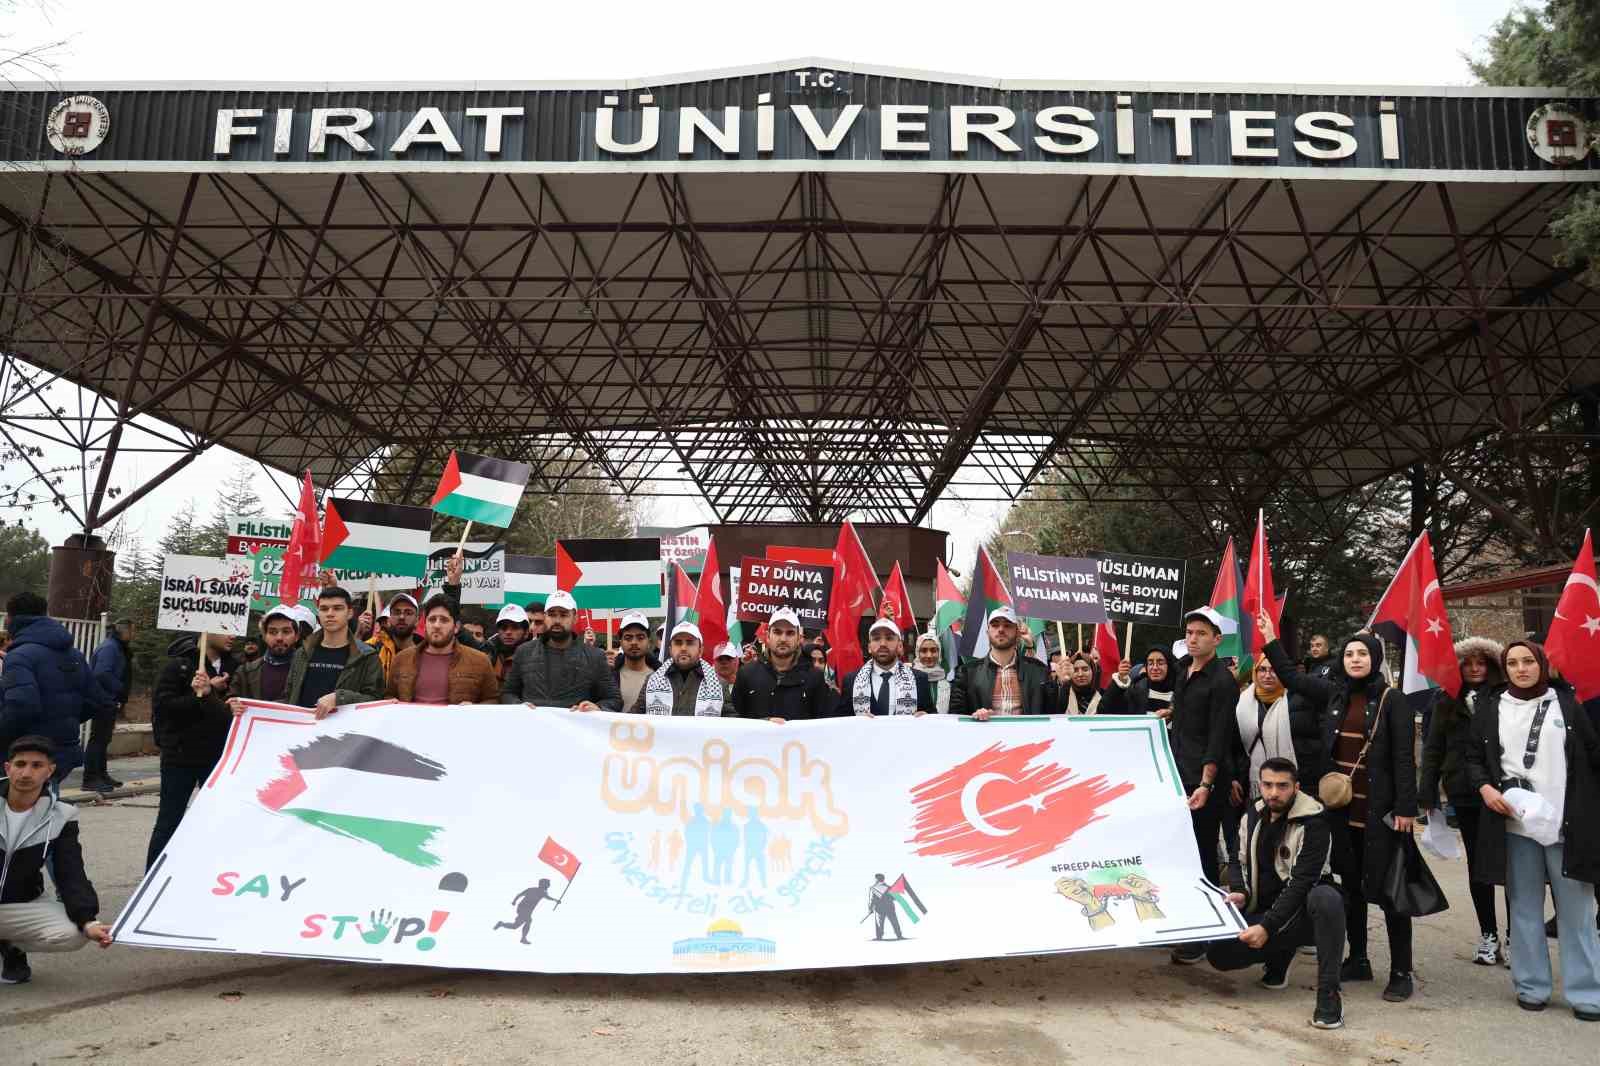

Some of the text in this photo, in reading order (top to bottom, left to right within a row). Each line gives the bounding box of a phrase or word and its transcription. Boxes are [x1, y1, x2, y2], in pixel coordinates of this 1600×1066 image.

[213, 92, 1401, 161] FIRAT ÜNİVERSİTESİ
[751, 565, 824, 584] EY DÜNYA
[1013, 565, 1096, 586] FİLİSTİN'DE
[164, 576, 249, 599] İSRAİL SAVAŞ
[748, 582, 789, 598] DAHA
[793, 587, 823, 603] KAÇ
[1015, 586, 1099, 604] KATLİAM VAR
[1132, 585, 1178, 600] BOYUN
[162, 597, 247, 616] SUÇLUSUDUR
[741, 602, 778, 614] ÇOCUK
[1103, 597, 1160, 617] EĞMEZ!
[1051, 855, 1143, 873] #FREEPALESTINE
[211, 871, 307, 902] SAY
